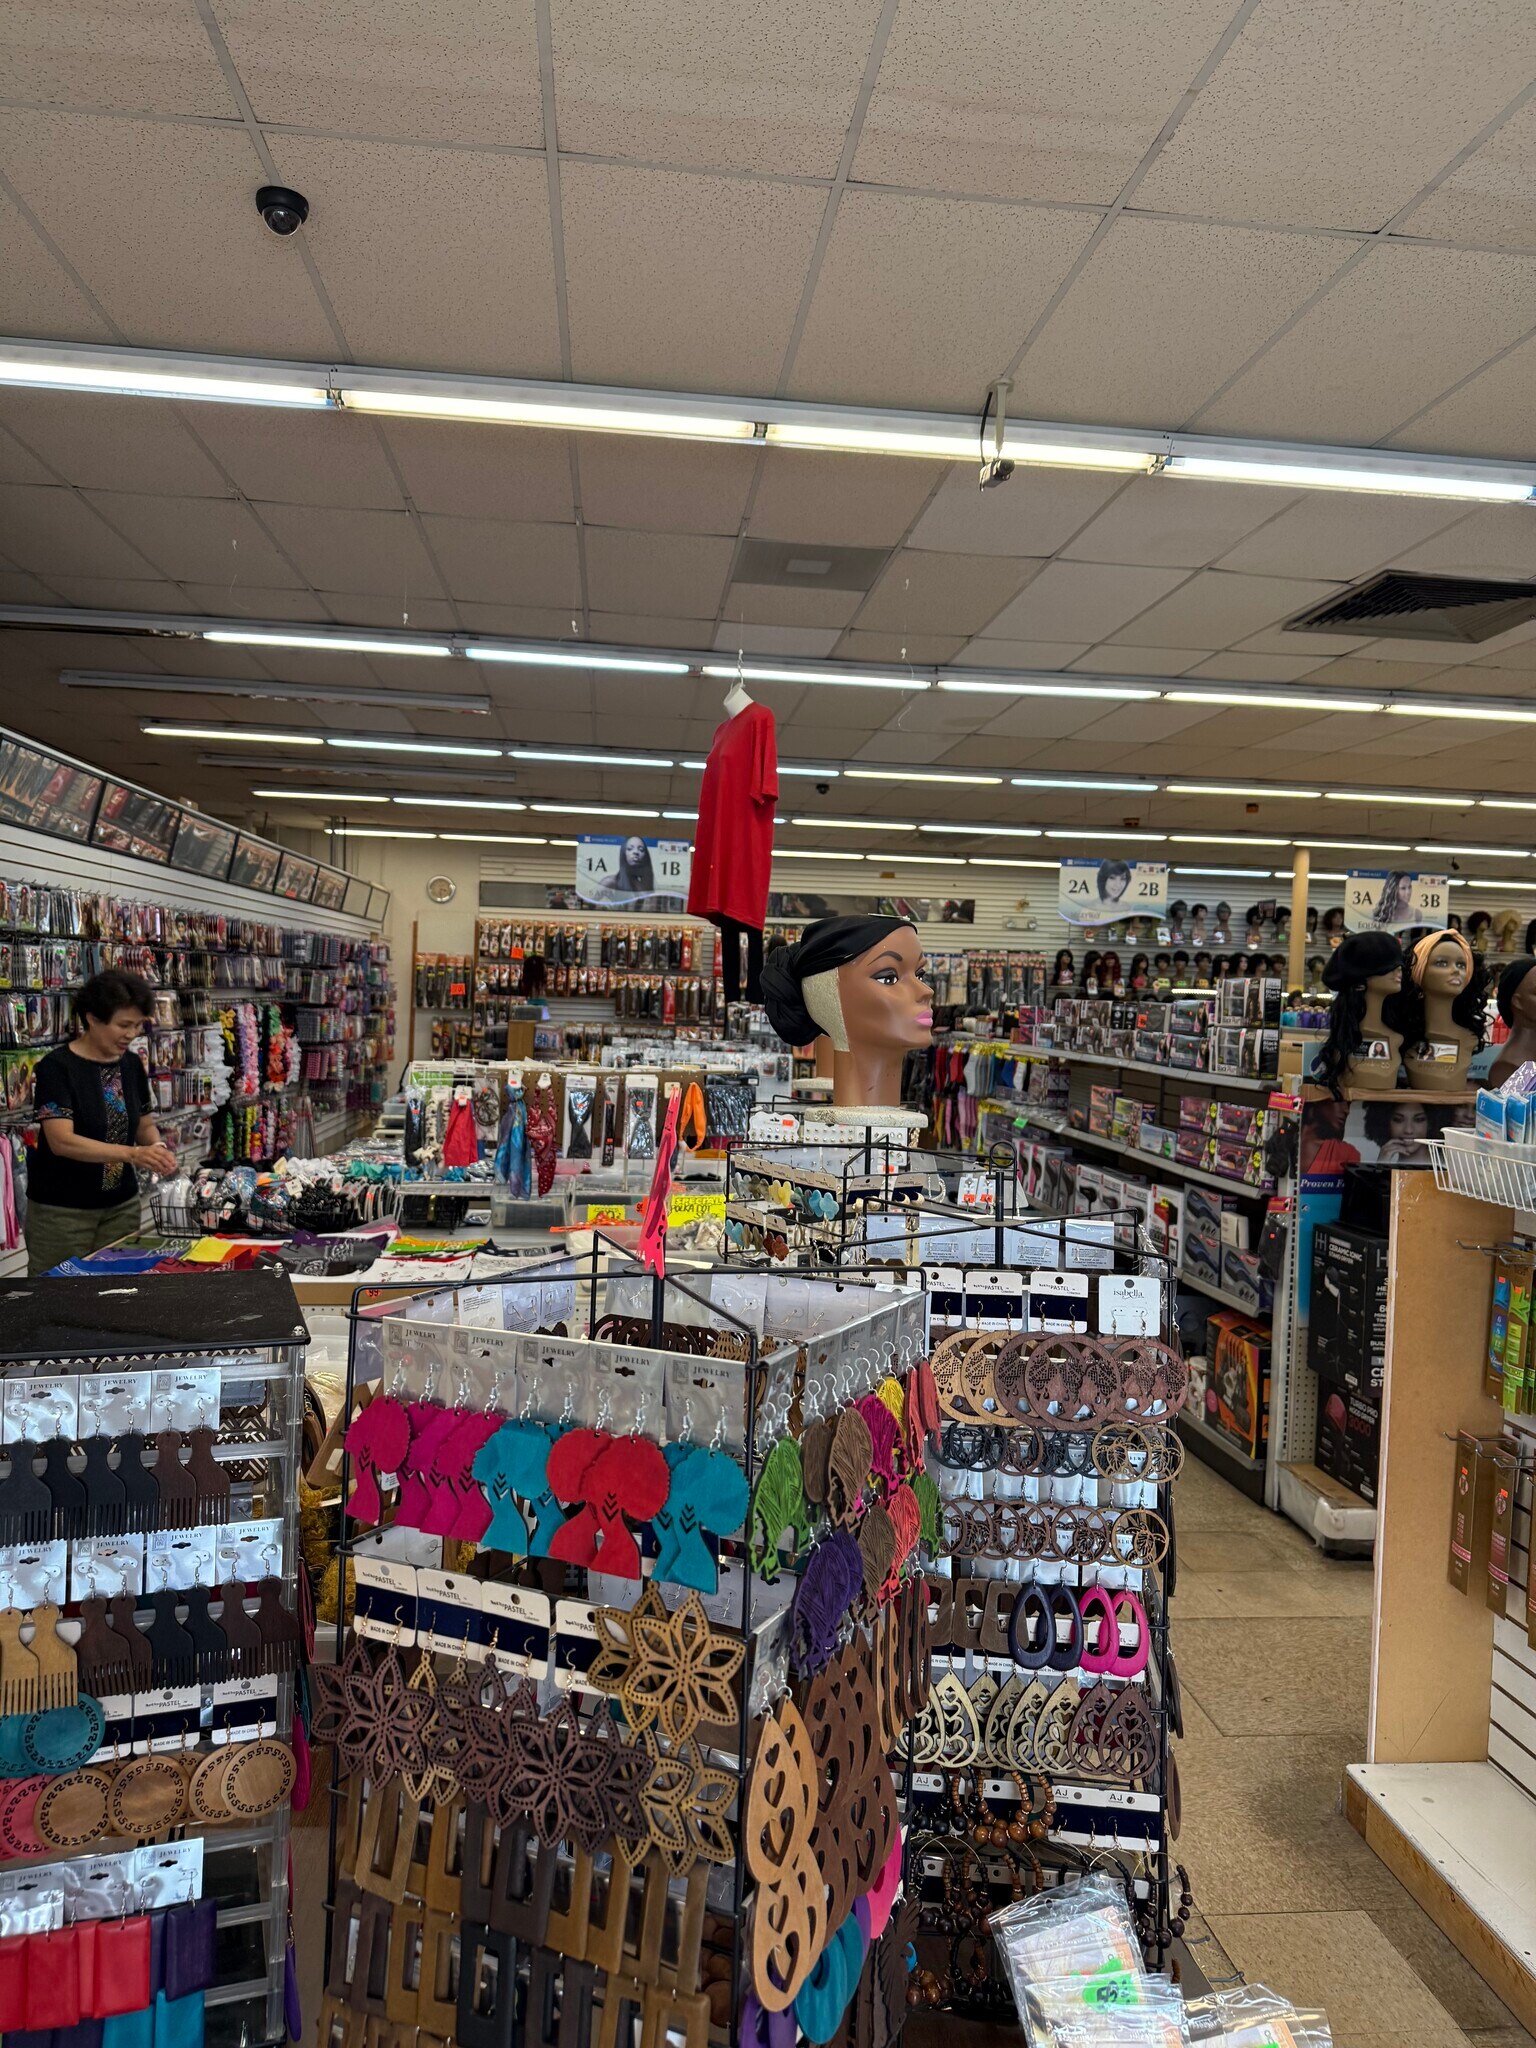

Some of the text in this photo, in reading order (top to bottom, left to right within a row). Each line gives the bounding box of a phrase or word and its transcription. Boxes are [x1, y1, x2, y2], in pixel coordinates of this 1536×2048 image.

[586, 857, 608, 872] 1A
[661, 861, 681, 876] 1B
[1068, 879, 1090, 894] 2A
[1138, 882, 1159, 896] 2B
[1352, 890, 1373, 905] 3A
[1420, 893, 1440, 908] 3B
[1300, 1178, 1334, 1188] Proven
[674, 1196, 722, 1206] SPECIAL
[1328, 1243, 1350, 1256] CERAMIC
[1050, 1284, 1070, 1292] PASTEL
[1113, 1288, 1144, 1300] isabella
[405, 1328, 436, 1339] JEWELRY
[471, 1336, 504, 1347] JEWELRY
[541, 1346, 576, 1357] JEWELRY
[615, 1354, 651, 1366] JEWELRY
[693, 1366, 731, 1378] JEWELRY
[104, 1378, 138, 1387] JEWELRY
[175, 1374, 208, 1382] JEWELRY
[29, 1382, 65, 1391] JEWELRY
[239, 1526, 271, 1535] JEWELRY
[170, 1532, 204, 1541] JEWELRY
[96, 1539, 131, 1549] JEWELRY
[18, 1546, 53, 1556] JEWELRY
[375, 1575, 396, 1585] PASTEL
[439, 1589, 461, 1600] PASTEL
[504, 1604, 526, 1615] PASTEL
[370, 1625, 381, 1633] MADE
[434, 1640, 446, 1648] MADE
[235, 1688, 257, 1697] PASTEL
[158, 1699, 181, 1708] PASTEL
[915, 1776, 929, 1785] AJ
[1054, 1788, 1069, 1797] AJ
[1109, 1793, 1123, 1802] AJ
[159, 1847, 192, 1858] JEWELRY
[89, 1859, 123, 1870] JEWELRY
[18, 1871, 53, 1882] JEWELRY
